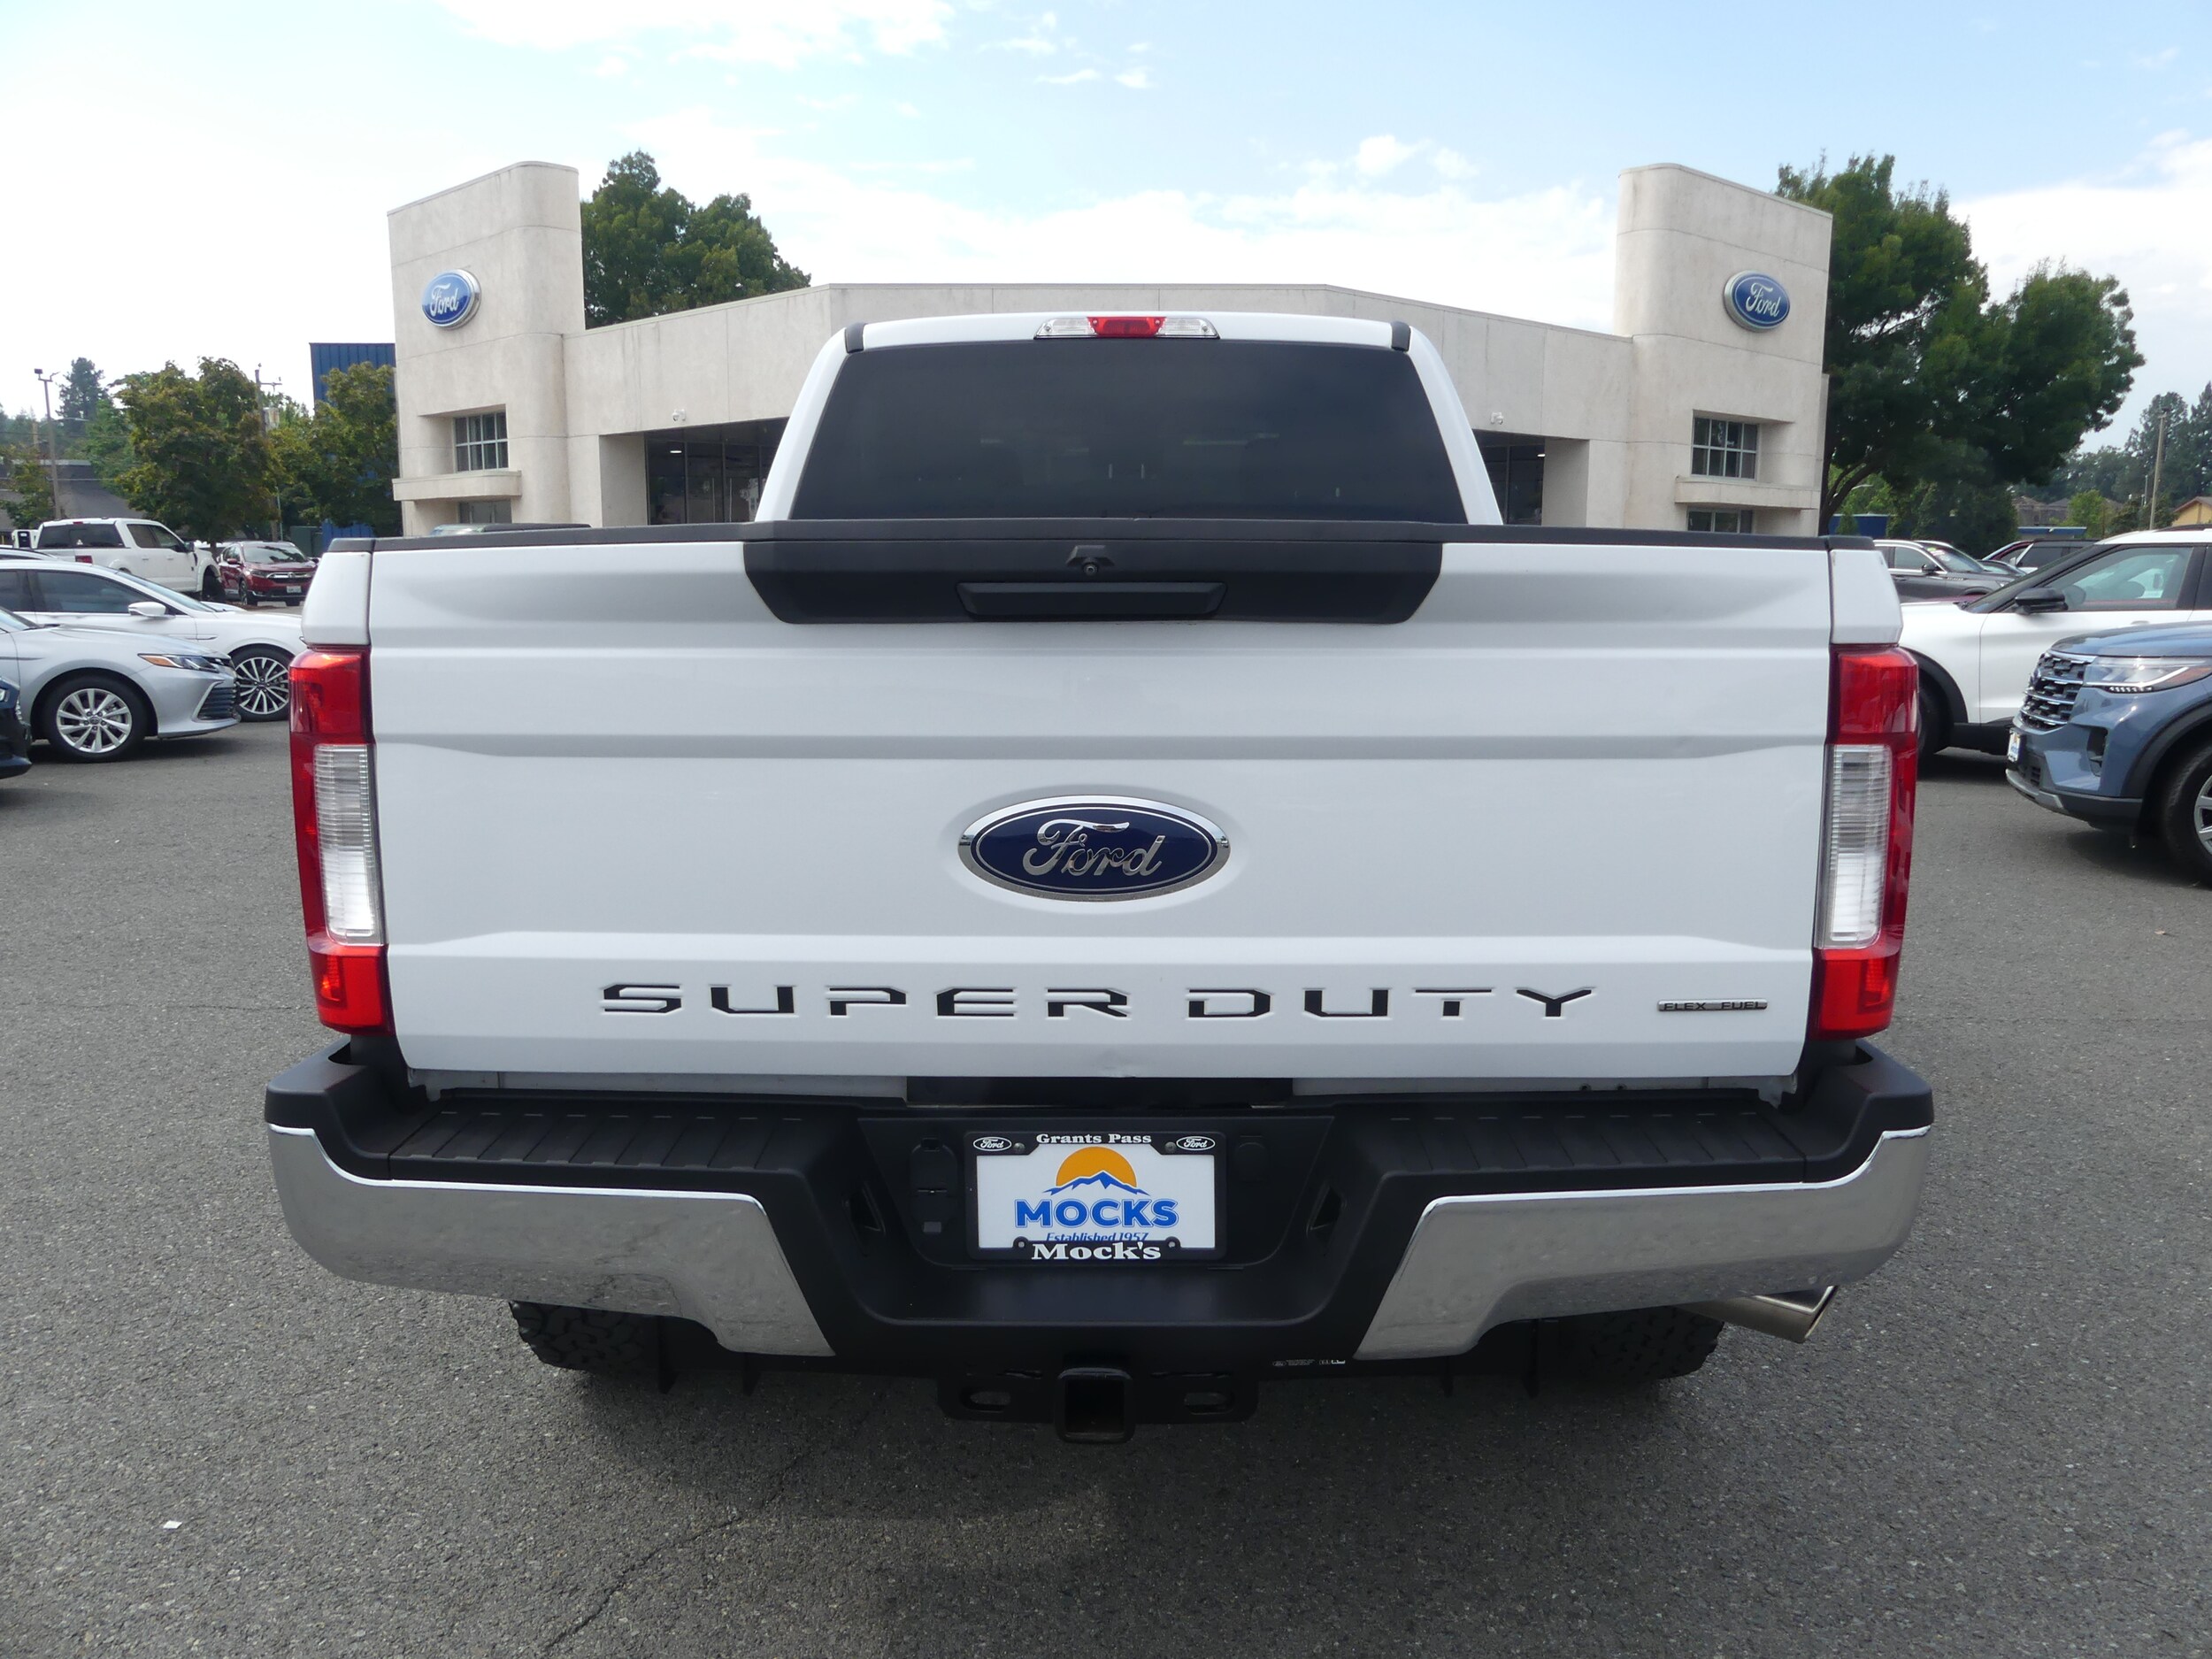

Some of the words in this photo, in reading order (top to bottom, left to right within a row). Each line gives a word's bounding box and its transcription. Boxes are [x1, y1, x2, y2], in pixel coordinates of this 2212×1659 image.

[430, 283, 459, 317] Ford
[1746, 282, 1781, 317] Ford
[1022, 818, 1166, 876] Ford
[603, 984, 1128, 1018] SUPER
[1188, 987, 1593, 1018] DUTY
[1663, 1002, 1706, 1010] FLEX
[1721, 1001, 1767, 1010] FUEL
[980, 1139, 1004, 1148] Ford
[1036, 1133, 1102, 1144] Grants
[1108, 1133, 1152, 1144] Pass
[1183, 1138, 1208, 1148] Ford
[1015, 1199, 1179, 1228] MOCKS
[1047, 1233, 1117, 1241] Established
[1032, 1241, 1162, 1260] Mock's
